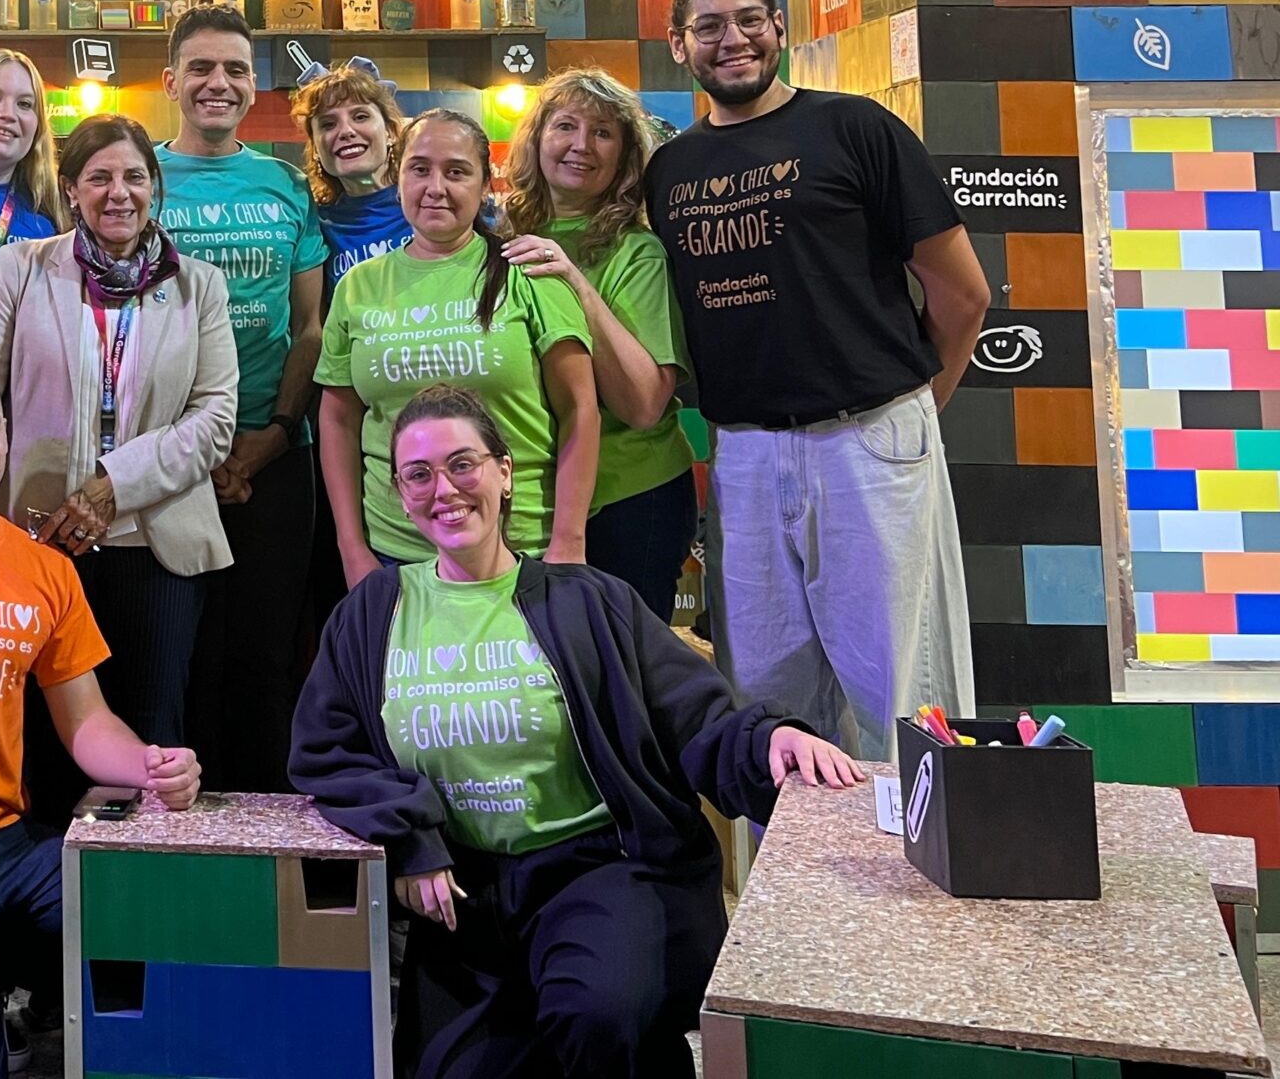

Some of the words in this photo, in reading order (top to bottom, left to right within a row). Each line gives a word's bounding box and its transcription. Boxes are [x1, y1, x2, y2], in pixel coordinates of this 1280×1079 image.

[950, 167, 1059, 189] Fundación
[669, 181, 698, 206] CON
[669, 208, 679, 220] el
[682, 191, 770, 217] compromiso
[773, 188, 792, 200] es
[953, 187, 1057, 209] Garrahan
[160, 209, 191, 230] CON
[182, 228, 273, 245] compromiso
[275, 231, 288, 240] es
[687, 210, 773, 257] GRANDE
[698, 273, 769, 295] Fundación
[702, 290, 770, 309] Garrahan
[362, 311, 397, 330] CON
[364, 333, 376, 345] el
[380, 323, 483, 341] compromiso
[489, 322, 506, 333] es
[383, 340, 489, 383] GRANDE
[19, 641, 33, 654] es
[387, 648, 420, 679] CON
[387, 683, 401, 700] el
[407, 675, 520, 697] compromiso
[525, 673, 547, 687] es
[411, 698, 528, 750] GRANDE
